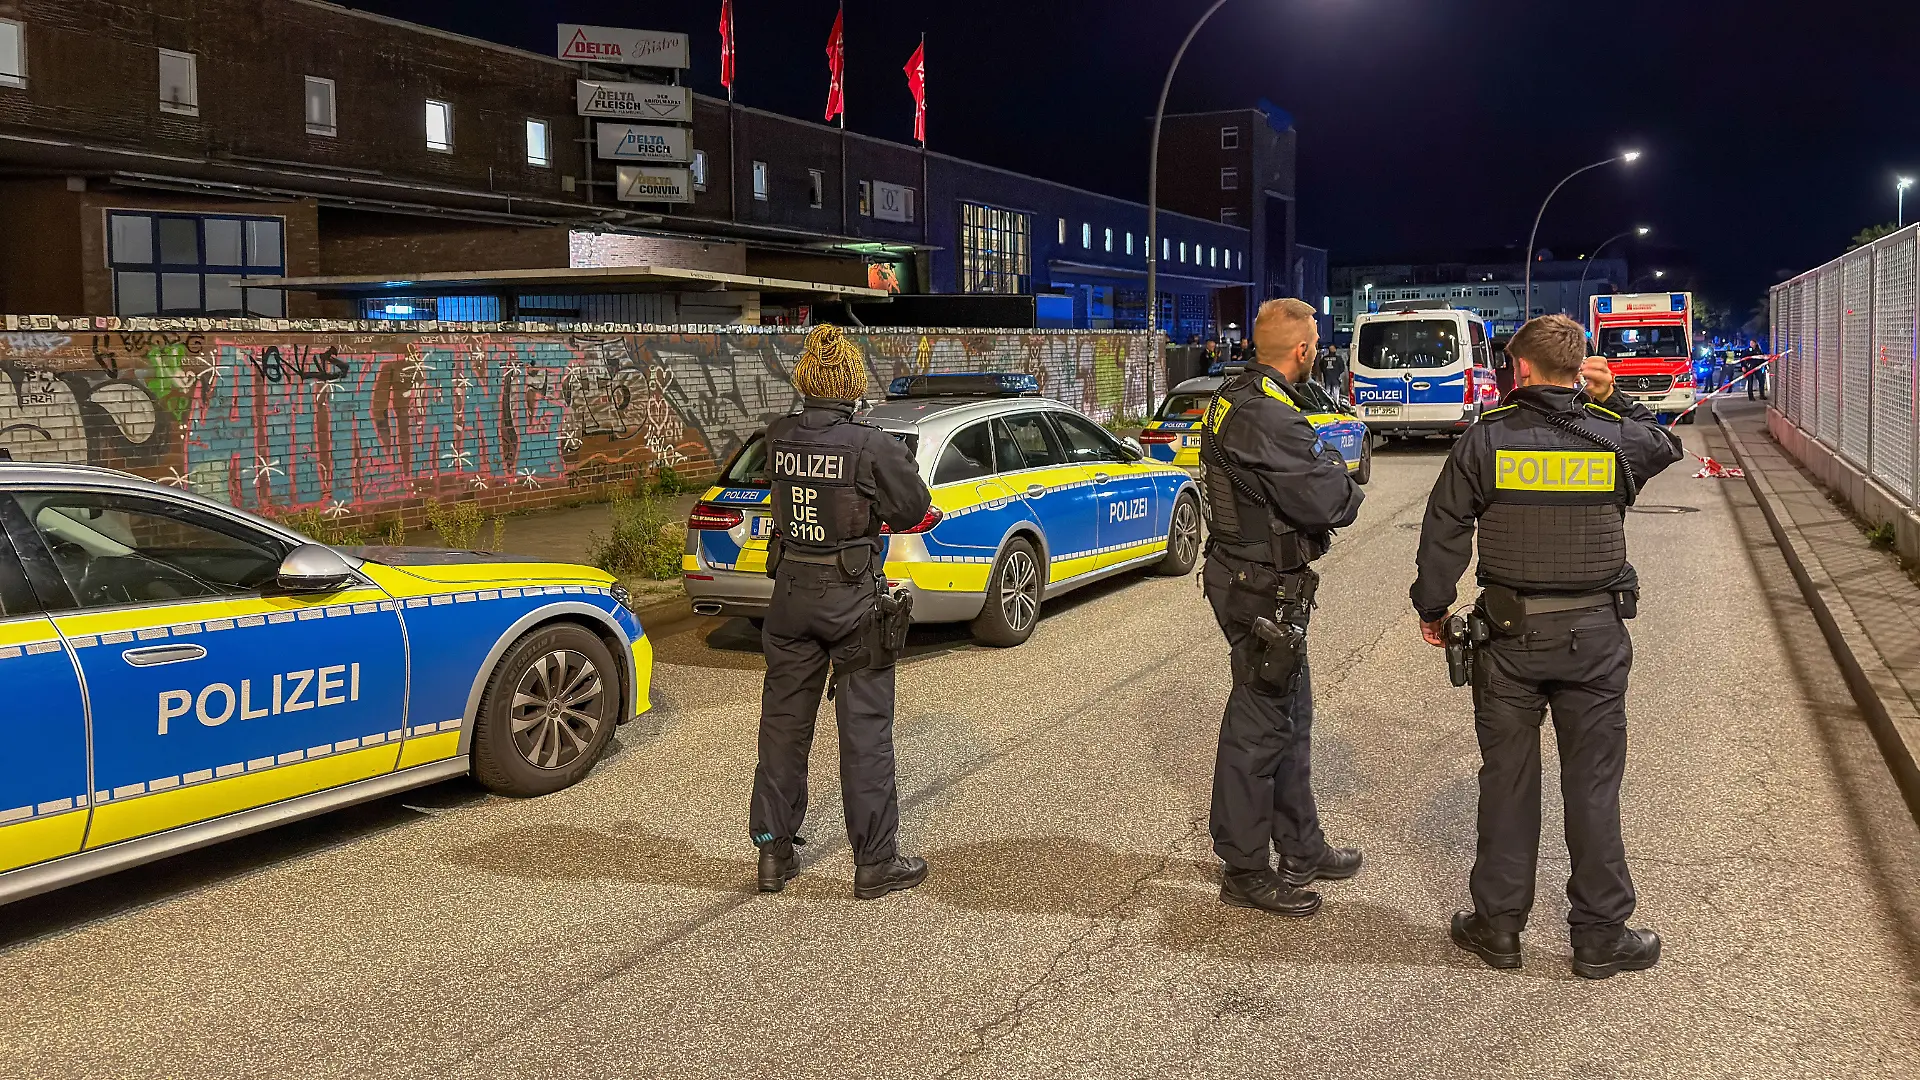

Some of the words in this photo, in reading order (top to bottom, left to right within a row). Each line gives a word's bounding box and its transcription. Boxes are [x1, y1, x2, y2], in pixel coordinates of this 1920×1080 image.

[575, 41, 622, 56] DELTA
[598, 90, 635, 102] DELTA
[595, 100, 641, 111] FLEISCH
[628, 134, 665, 145] DELTA
[638, 144, 671, 154] FISCH
[638, 176, 673, 185] DELTA
[639, 185, 680, 195] CONVIN
[1360, 390, 1402, 400] POLIZEI
[775, 451, 844, 479] POLIZEI
[1499, 456, 1613, 486] POLIZEI
[723, 490, 760, 500] POLIZEI
[791, 486, 818, 504] BP
[792, 504, 818, 524] UE
[1109, 497, 1148, 524] POLIZEI
[790, 521, 826, 542] 3110
[158, 662, 361, 736] POLIZEI
